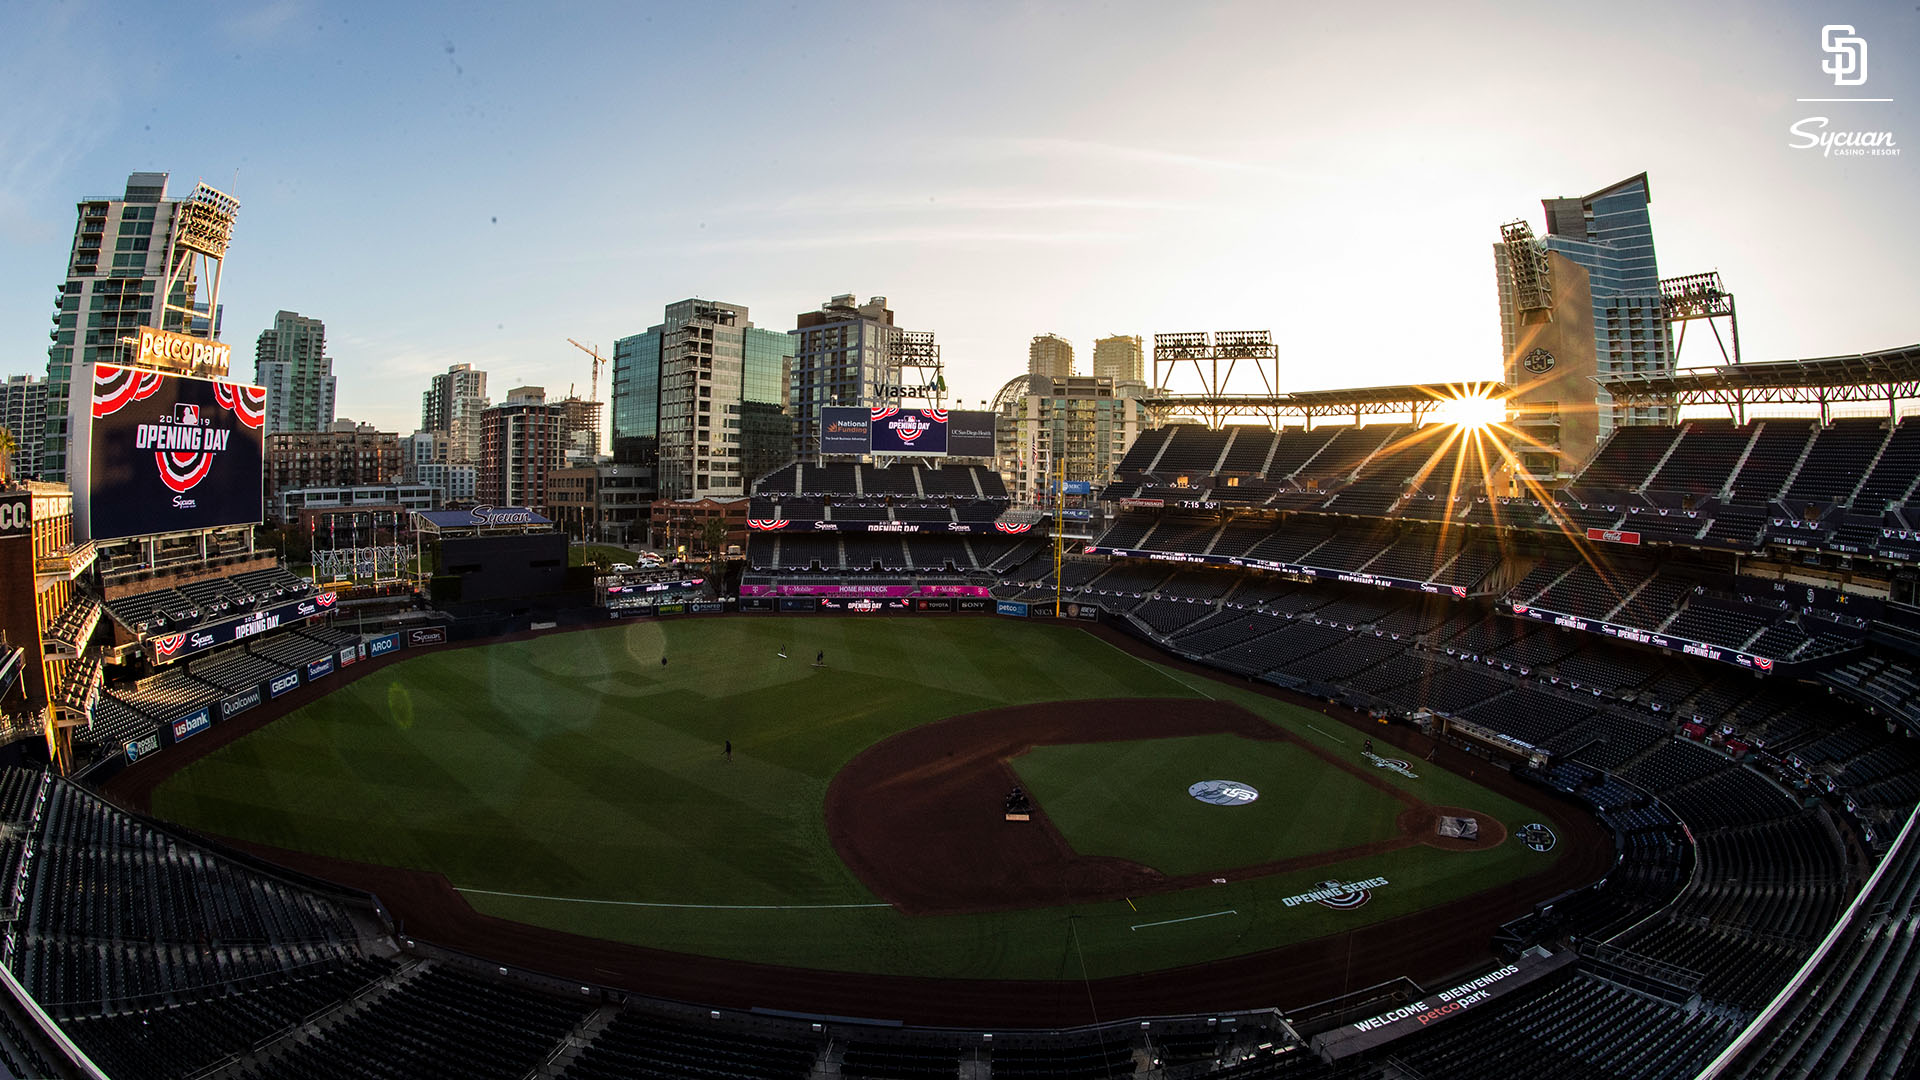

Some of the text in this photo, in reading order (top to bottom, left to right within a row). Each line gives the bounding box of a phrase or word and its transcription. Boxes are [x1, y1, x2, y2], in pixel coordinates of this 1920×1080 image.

[874, 383, 926, 398] Viasat
[837, 427, 868, 435] Funding
[888, 421, 931, 430] OPENING DAY
[136, 424, 230, 451] OPENING DAY
[1183, 501, 1200, 509] 7:15
[470, 504, 531, 529] Sycuan
[868, 524, 903, 532] OPENING
[311, 544, 416, 566] NATIONAL
[1773, 583, 1786, 592] RAK
[998, 604, 1017, 612] petco
[1034, 608, 1053, 616] NECA
[235, 614, 280, 640] OPENING DAY
[1555, 616, 1577, 629] OPENING
[1617, 628, 1640, 641] OPENING
[371, 640, 392, 653] ARCO
[1682, 644, 1721, 660] OPENING DAY
[271, 673, 298, 693] GEICO
[223, 692, 259, 715] Qualcomm
[138, 734, 157, 748] ROCKET
[139, 742, 159, 756] LEAGUE
[1281, 876, 1389, 907] OPENING SERIES
[1353, 963, 1519, 1033] WELCOME BIENVENIDOS
